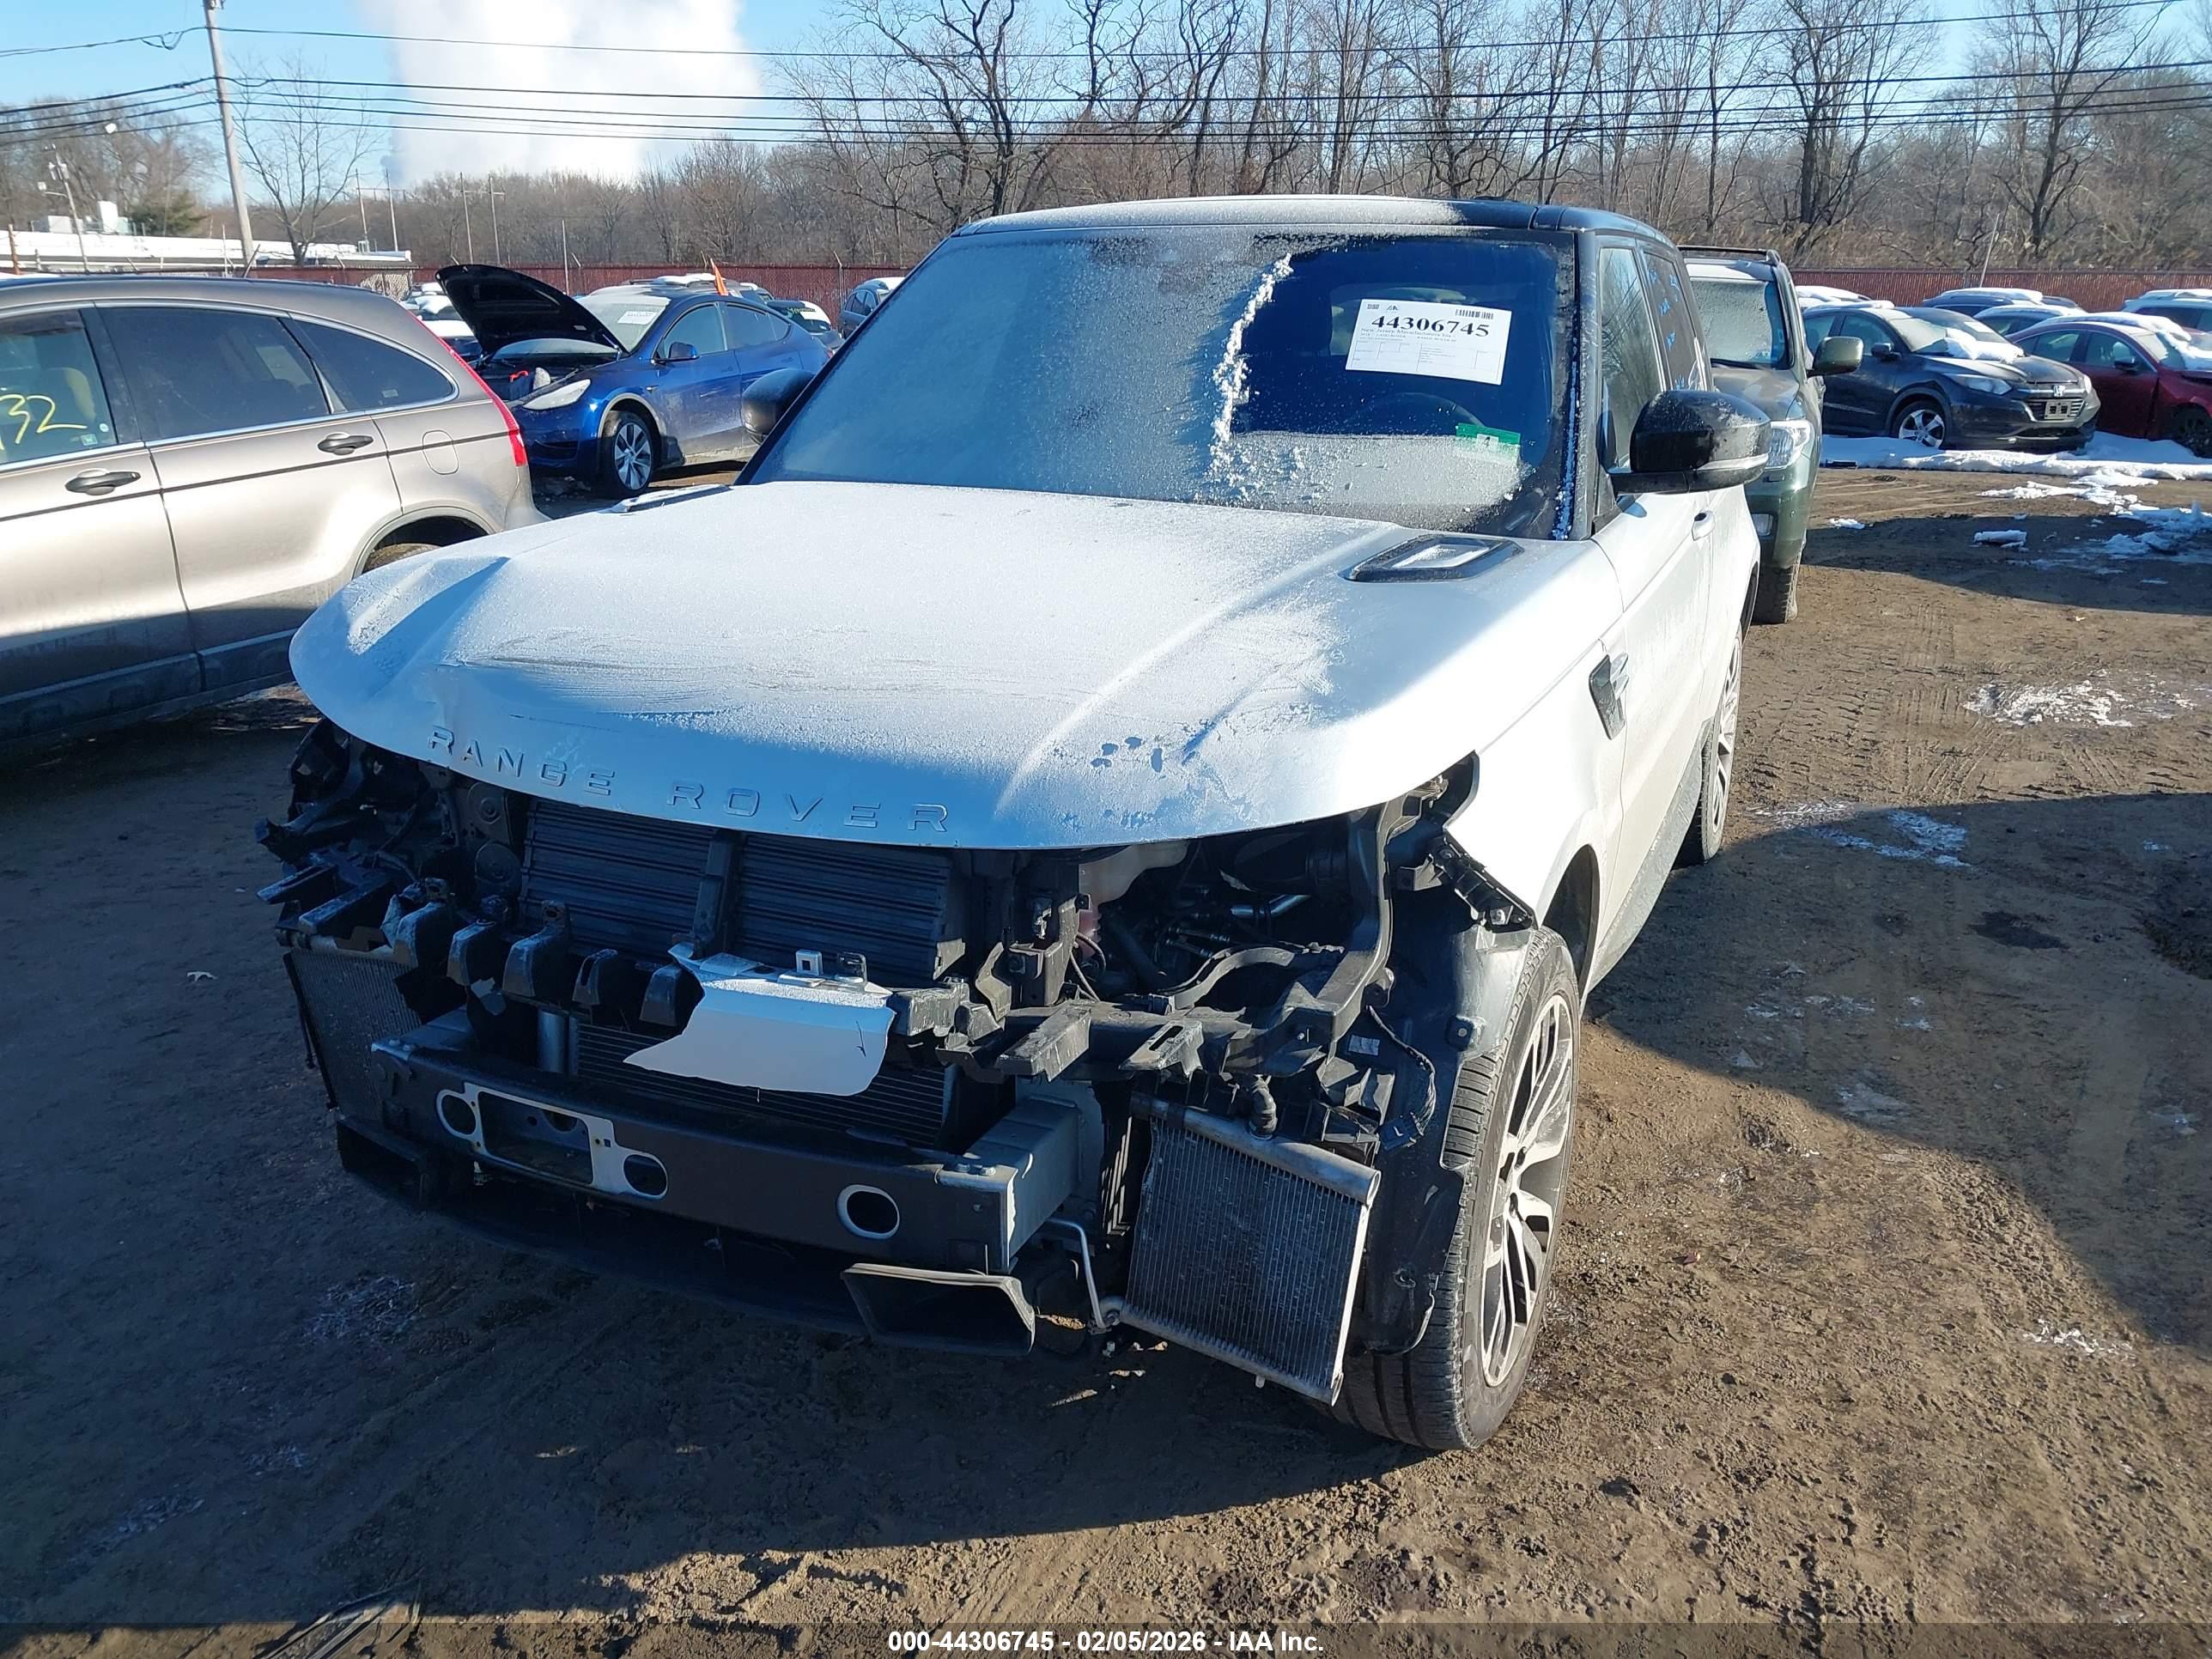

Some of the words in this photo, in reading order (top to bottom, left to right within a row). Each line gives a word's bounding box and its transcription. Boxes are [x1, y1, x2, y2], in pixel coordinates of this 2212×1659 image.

[1371, 315, 1491, 337] 44306745
[0, 393, 88, 450] 32
[428, 725, 616, 797] RANGE
[667, 782, 948, 832] ROVER
